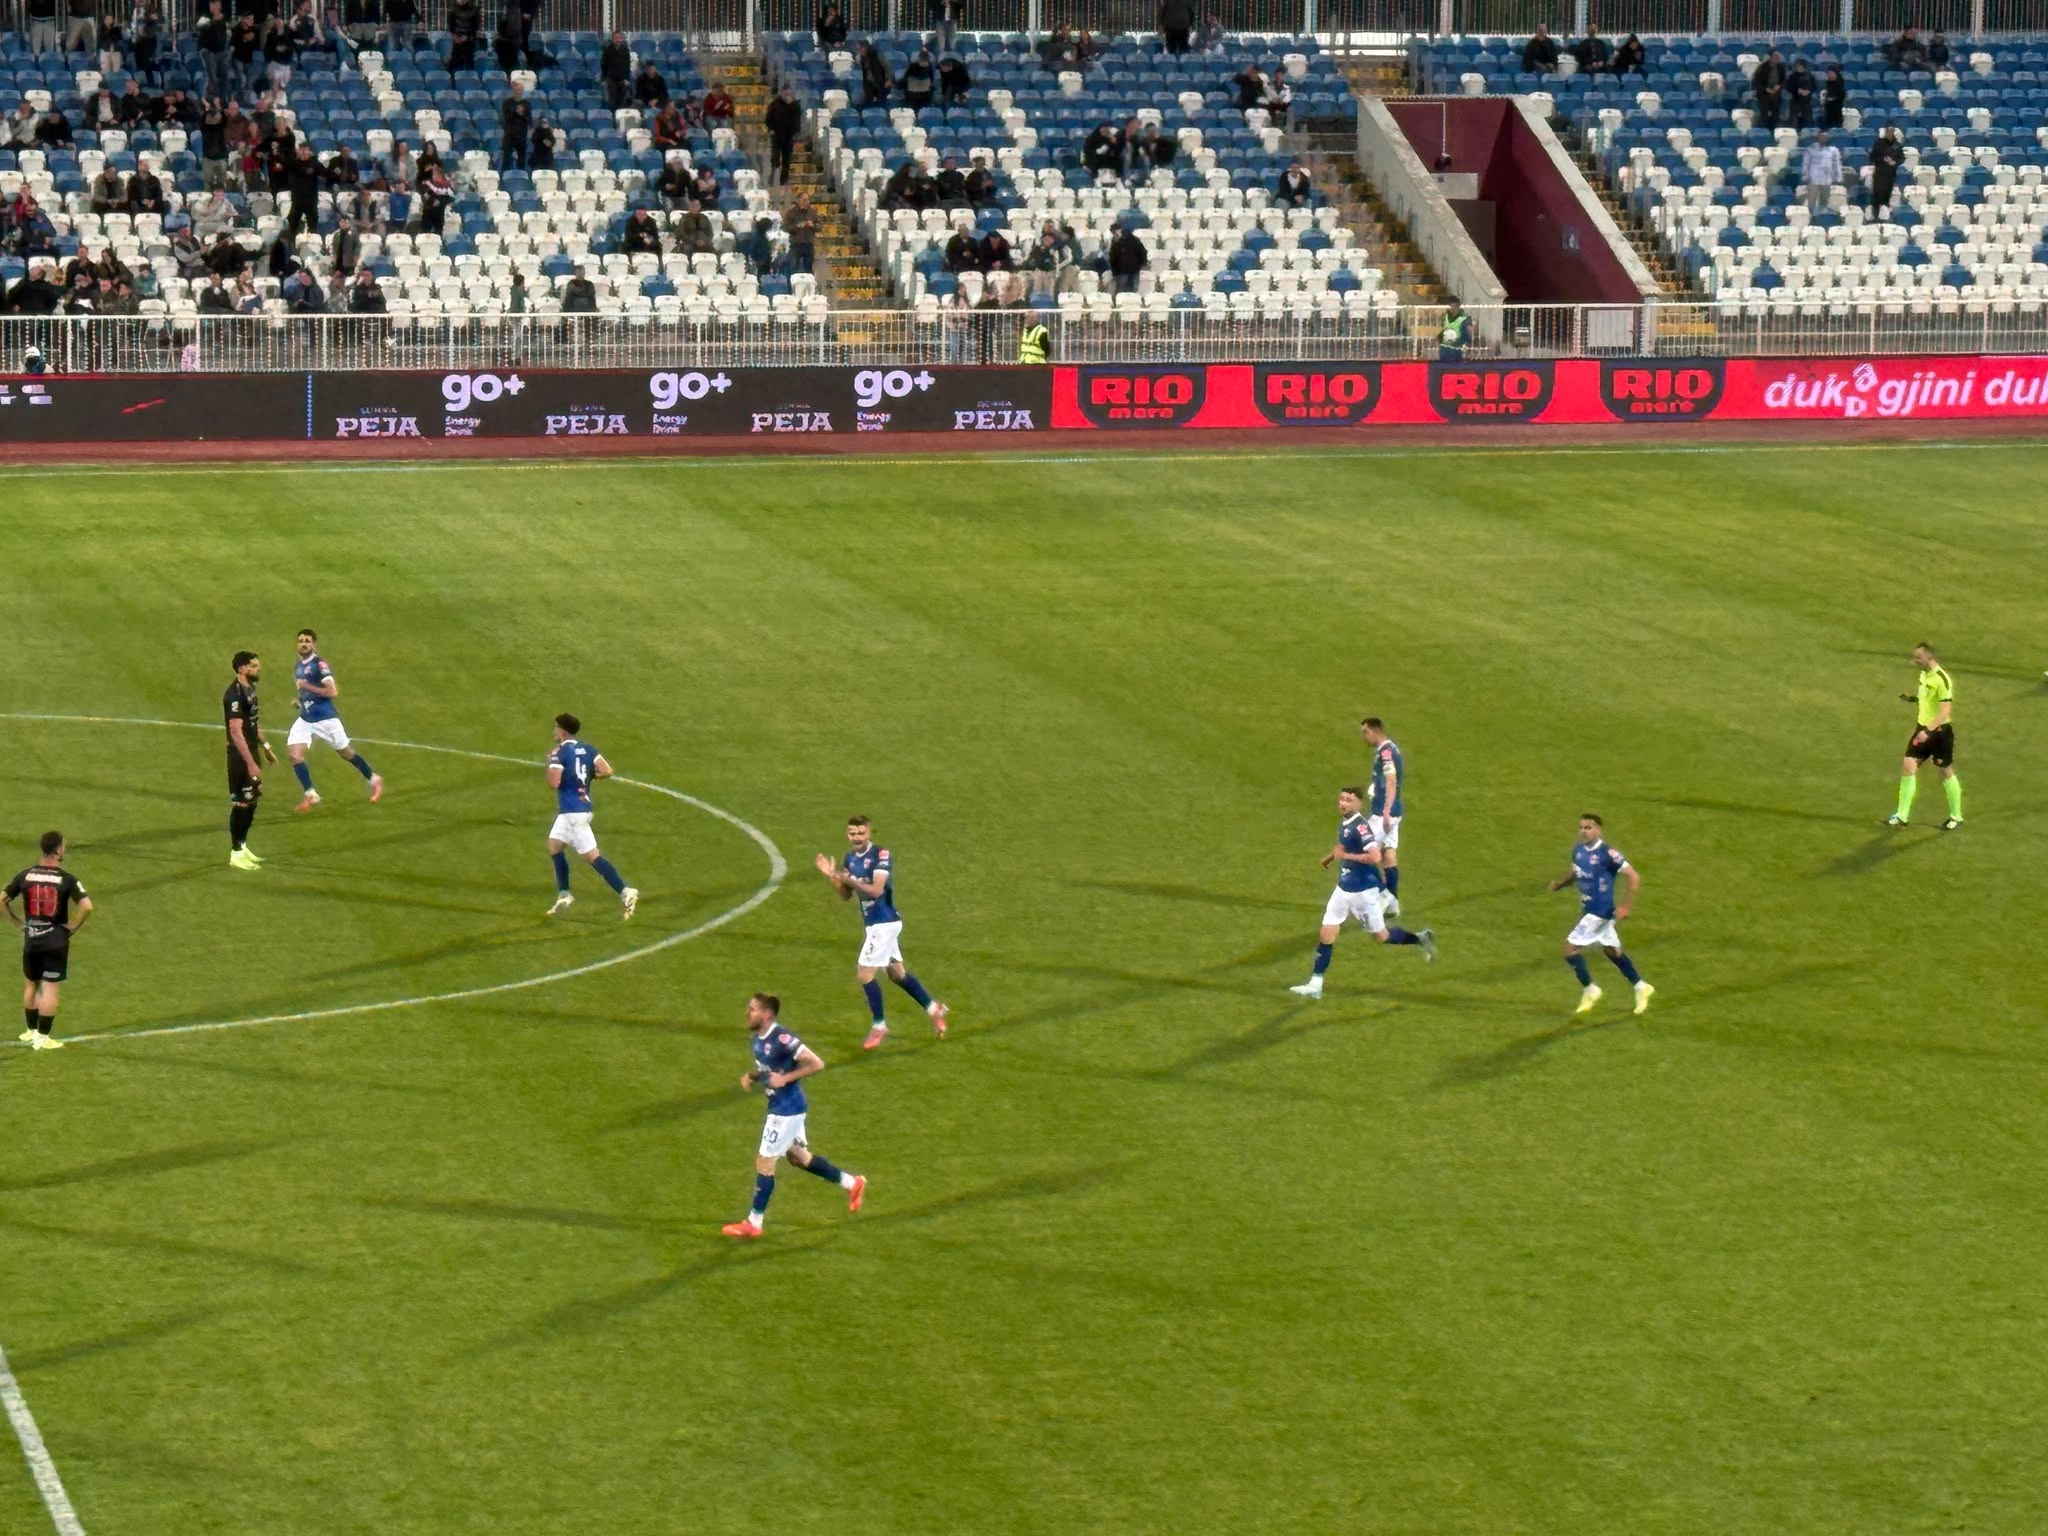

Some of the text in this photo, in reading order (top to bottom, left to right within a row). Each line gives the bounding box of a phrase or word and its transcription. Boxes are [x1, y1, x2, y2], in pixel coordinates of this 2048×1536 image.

[442, 374, 526, 411] go+
[650, 372, 732, 409] go+
[854, 370, 936, 407] go+
[1091, 375, 1193, 404] RIO
[1267, 374, 1368, 404] RIO
[1441, 371, 1541, 399] RIO
[1613, 369, 1713, 399] RIO
[335, 417, 421, 437] PEJA
[545, 414, 629, 435] PEJA
[751, 412, 833, 432] PEJA
[954, 409, 1034, 430] PEJA
